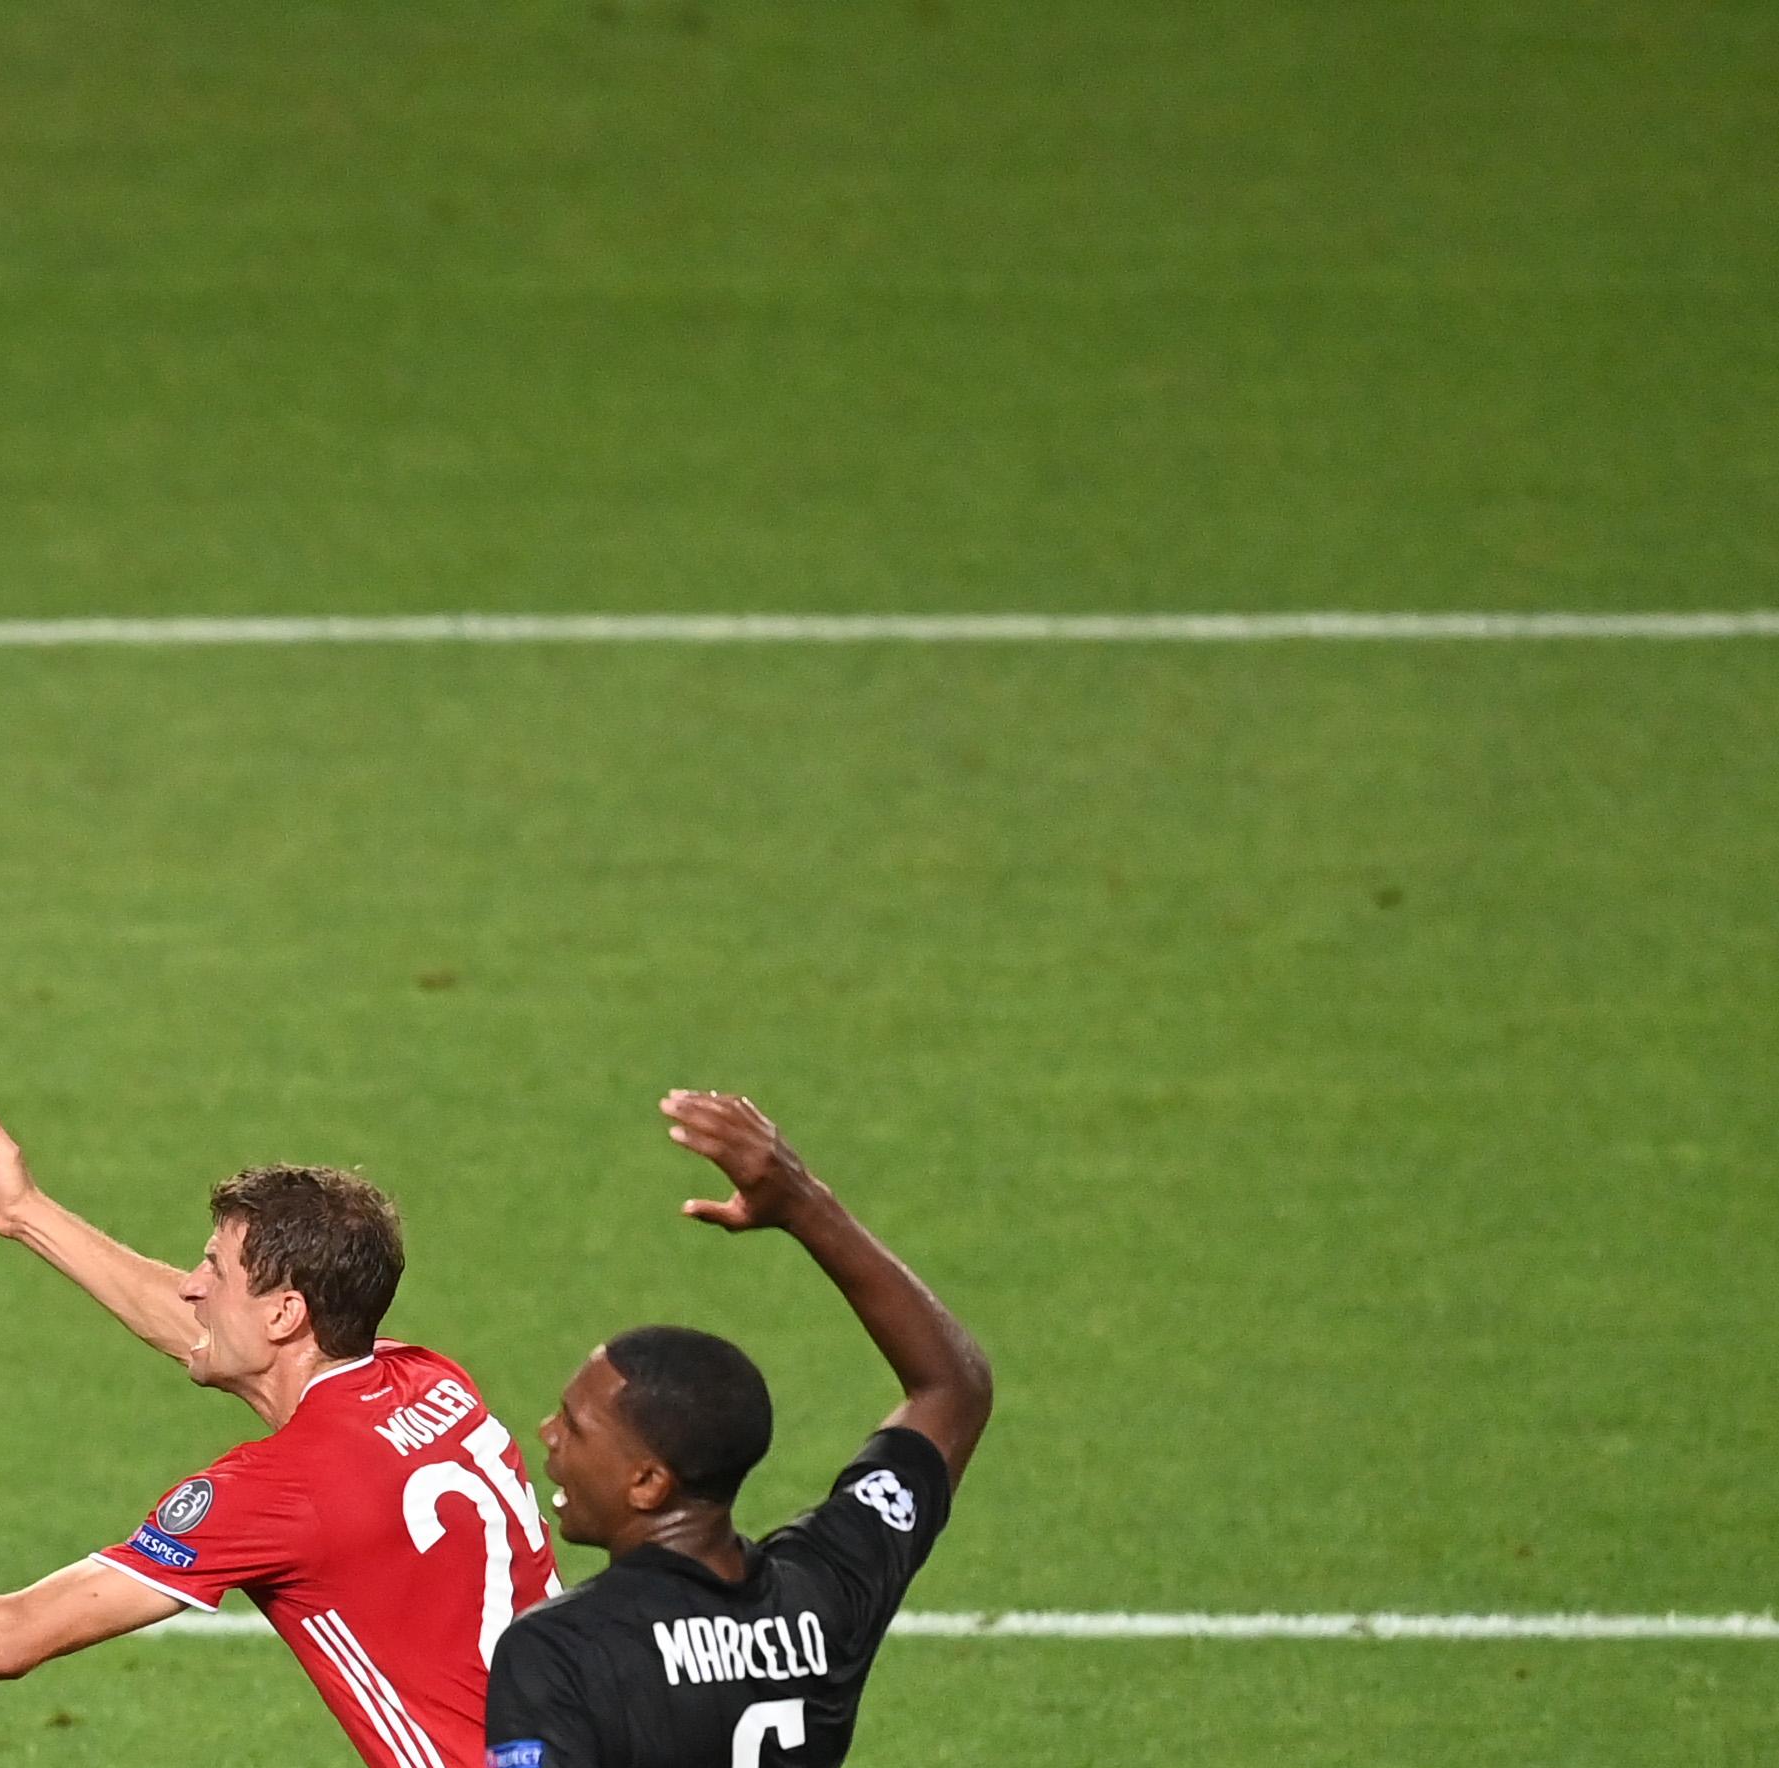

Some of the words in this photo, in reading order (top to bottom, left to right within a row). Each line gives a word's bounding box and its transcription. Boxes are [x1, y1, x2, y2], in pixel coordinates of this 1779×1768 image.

[373, 1378, 480, 1457] MÜLLER
[136, 1530, 195, 1569] RESPECT
[653, 1611, 828, 1686] MARCELO
